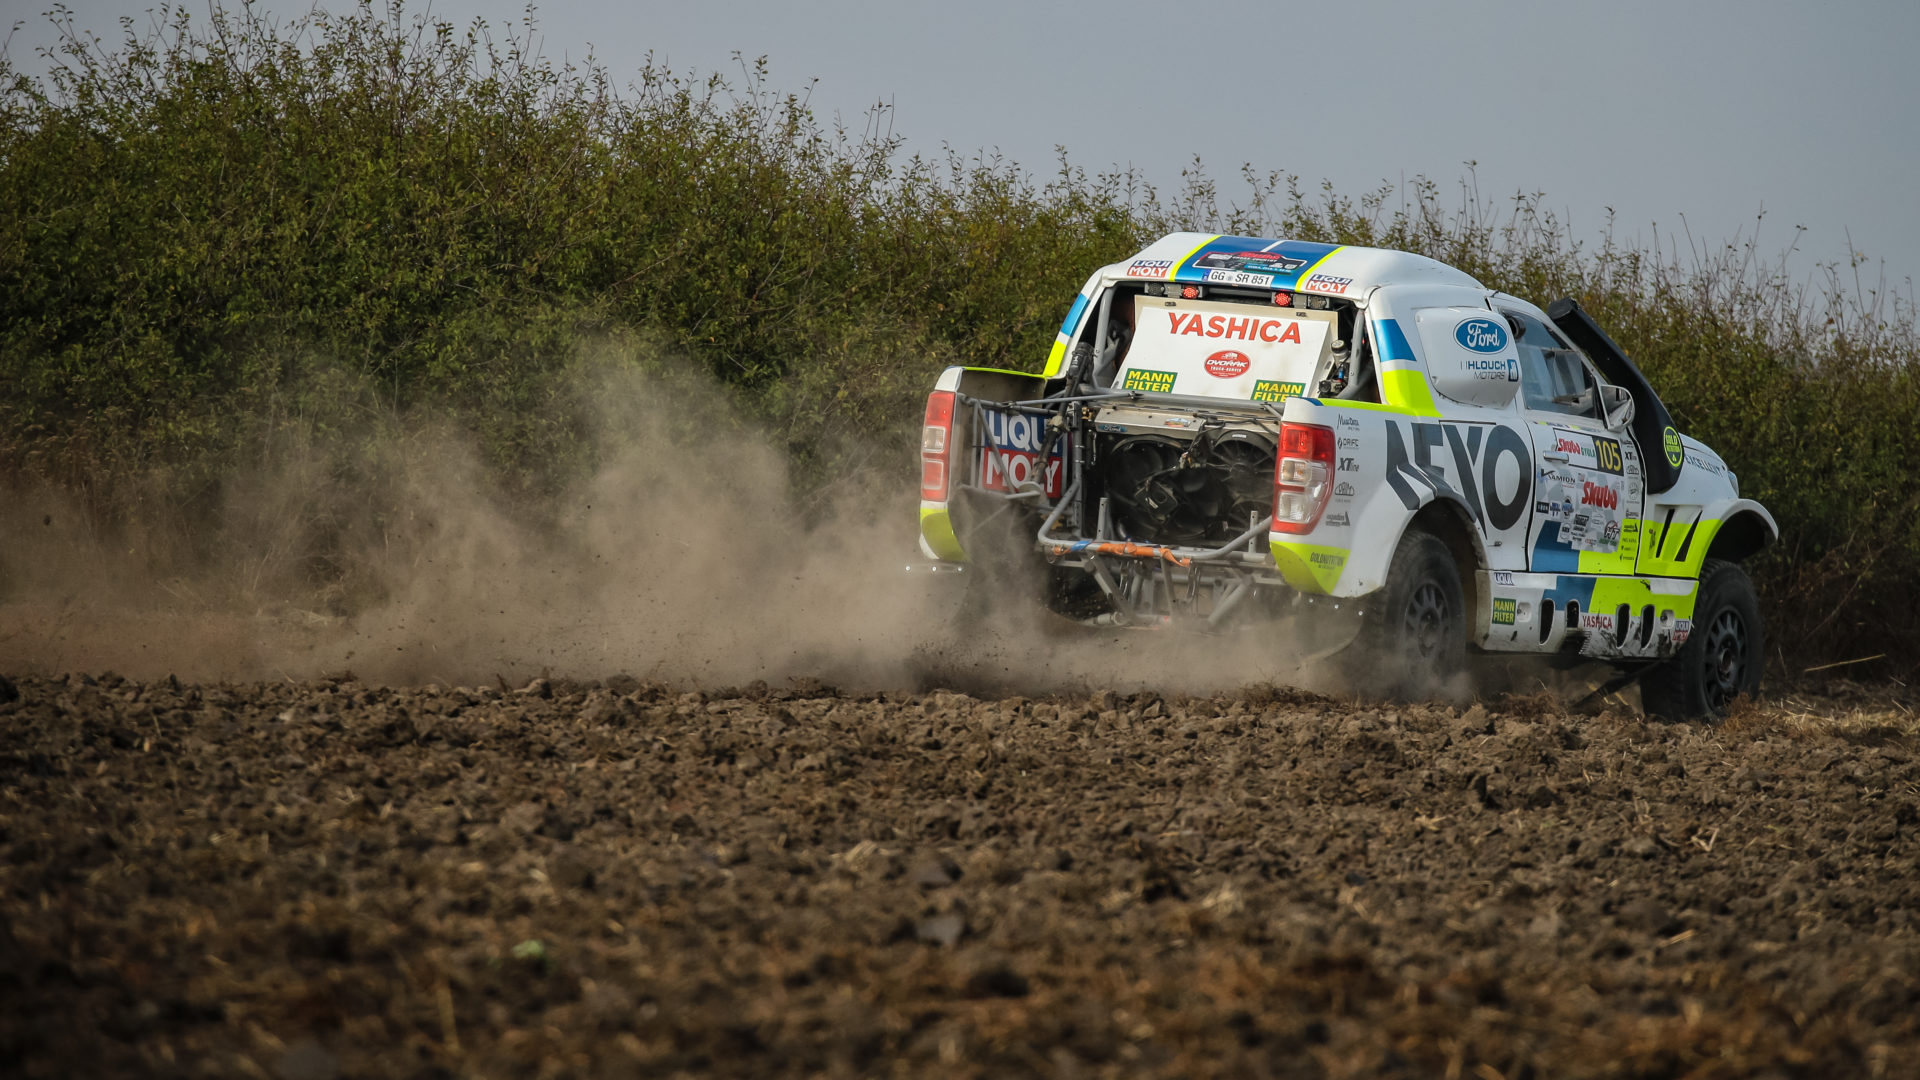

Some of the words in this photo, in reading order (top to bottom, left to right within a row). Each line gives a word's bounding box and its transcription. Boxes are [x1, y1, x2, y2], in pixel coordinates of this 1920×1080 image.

[1128, 267, 1167, 277] MOLY
[1211, 271, 1226, 280] GG
[1235, 273, 1250, 282] SR
[1251, 275, 1270, 285] 851
[1312, 275, 1351, 284] LIQUI
[1307, 281, 1347, 293] MOLY
[1169, 312, 1301, 344] YASHICA
[1467, 322, 1500, 348] Ford
[1468, 361, 1506, 370] HLOUCH
[1128, 371, 1174, 383] MANN
[1474, 371, 1506, 380] MOTORS
[1125, 380, 1171, 393] FILTER
[1257, 382, 1303, 394] MANN
[1253, 391, 1299, 403] FILTE
[1595, 440, 1622, 471] 105
[986, 451, 1060, 494] MOY
[1494, 601, 1515, 612] MANN
[1493, 611, 1514, 624] FILTER
[1583, 616, 1613, 629] YASHICA
